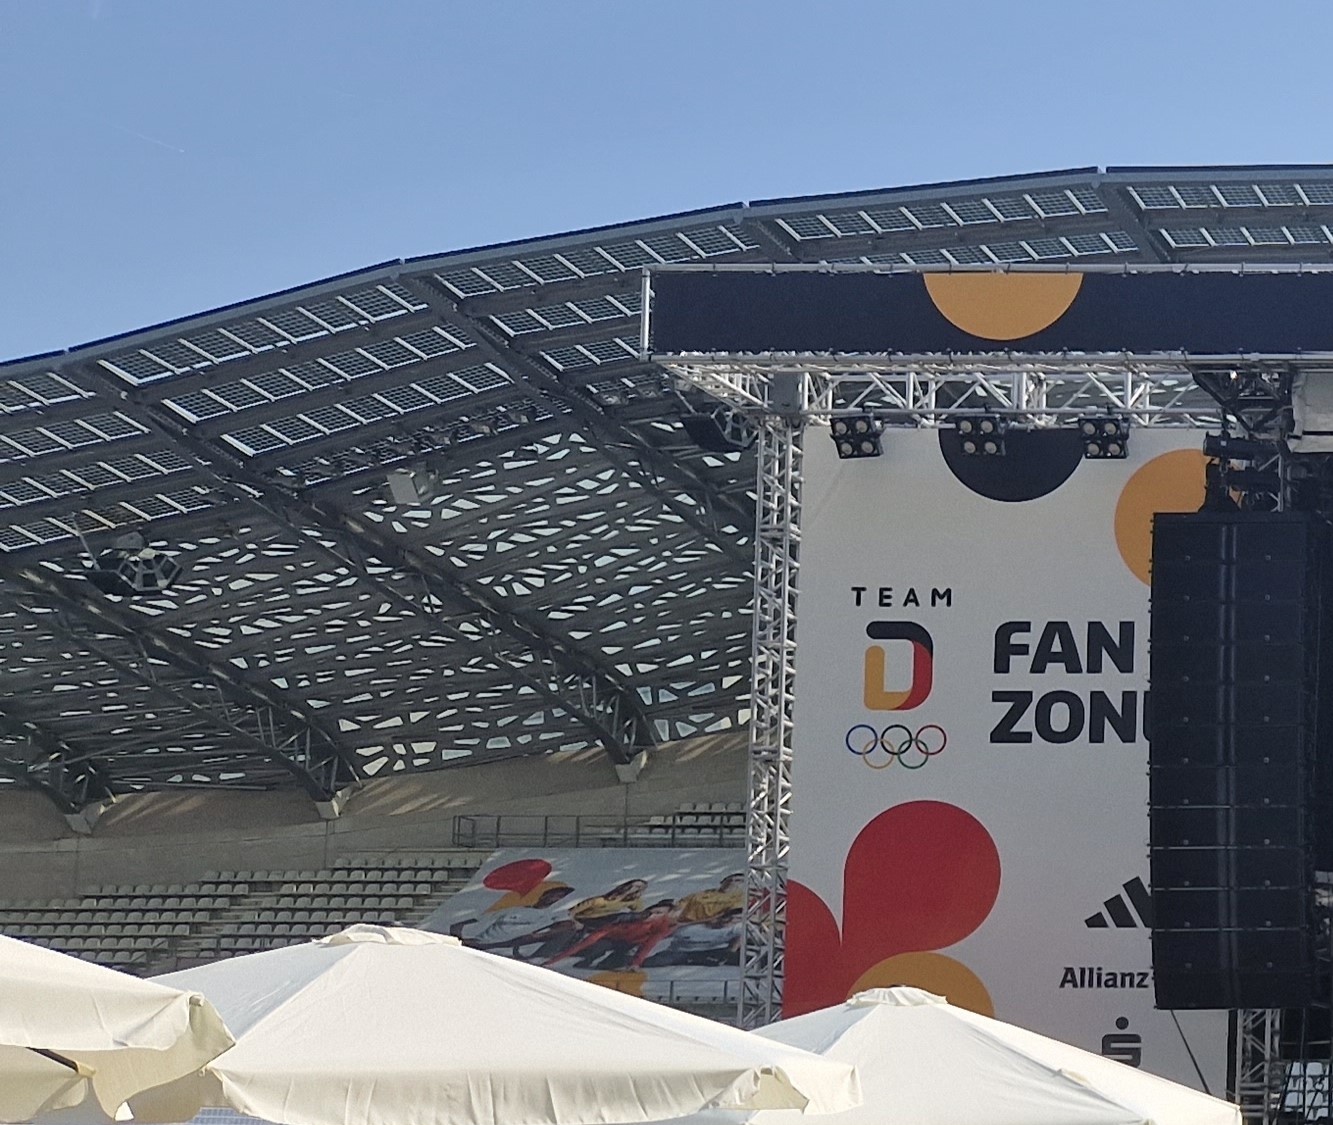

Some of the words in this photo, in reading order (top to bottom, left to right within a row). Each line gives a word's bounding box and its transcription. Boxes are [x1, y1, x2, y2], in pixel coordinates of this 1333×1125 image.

[851, 586, 952, 607] TEAM
[993, 620, 1136, 674] FAN
[989, 690, 1151, 744] ZON
[1058, 966, 1150, 989] Allianz
